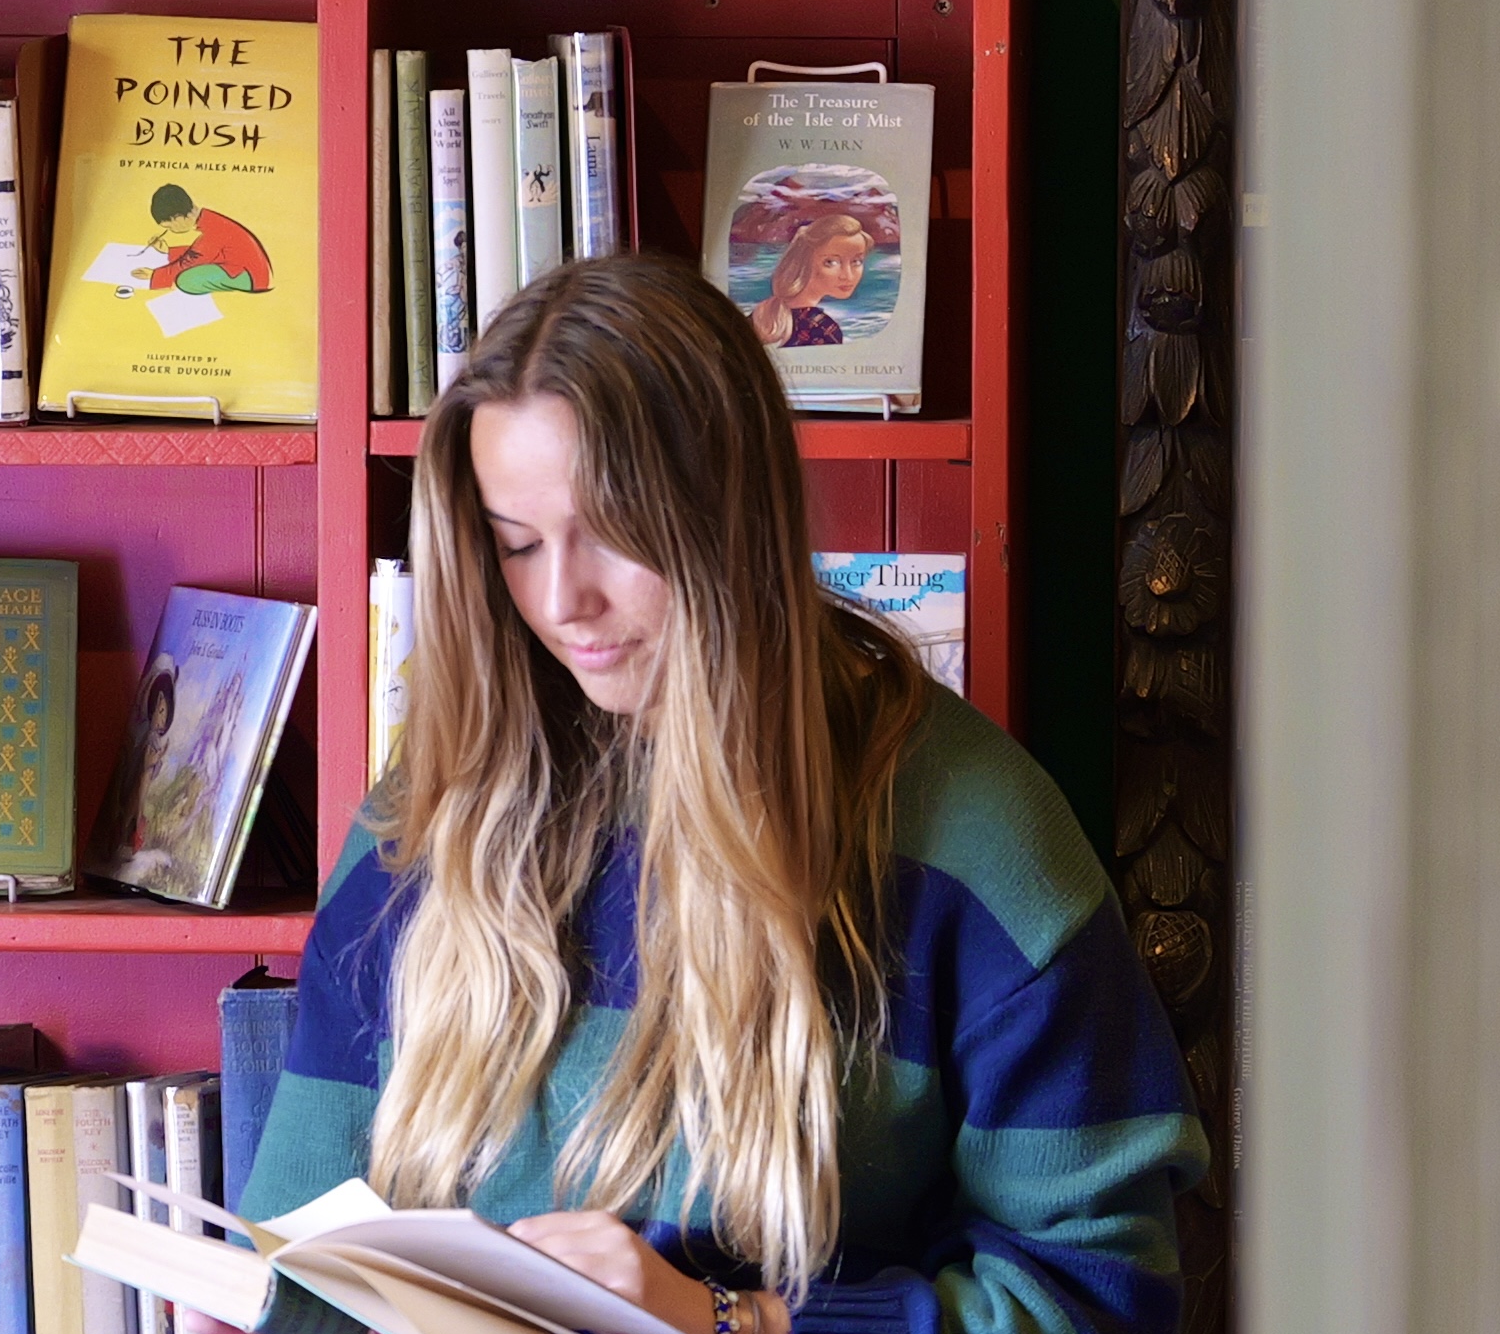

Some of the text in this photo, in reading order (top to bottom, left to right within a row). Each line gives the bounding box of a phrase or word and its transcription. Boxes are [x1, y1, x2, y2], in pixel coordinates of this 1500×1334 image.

[167, 36, 256, 67] THE
[472, 70, 509, 78] Gulliver's
[114, 76, 292, 112] POINTED
[769, 93, 879, 109] The Treasure
[443, 108, 455, 116] All
[437, 119, 461, 128] Alone
[525, 120, 549, 130] Swift
[743, 113, 902, 128] of the Isle of Mist
[128, 117, 267, 153] BRUSH
[436, 141, 462, 149] World
[586, 134, 601, 179] Lama
[119, 159, 275, 174] BY PATRICIA MILES MARTIN
[146, 352, 204, 363] ILLUSTRATED
[131, 364, 232, 377] ROGER DUVOISIN
[853, 363, 905, 375] LIBRARY
[0, 586, 42, 604] AGE
